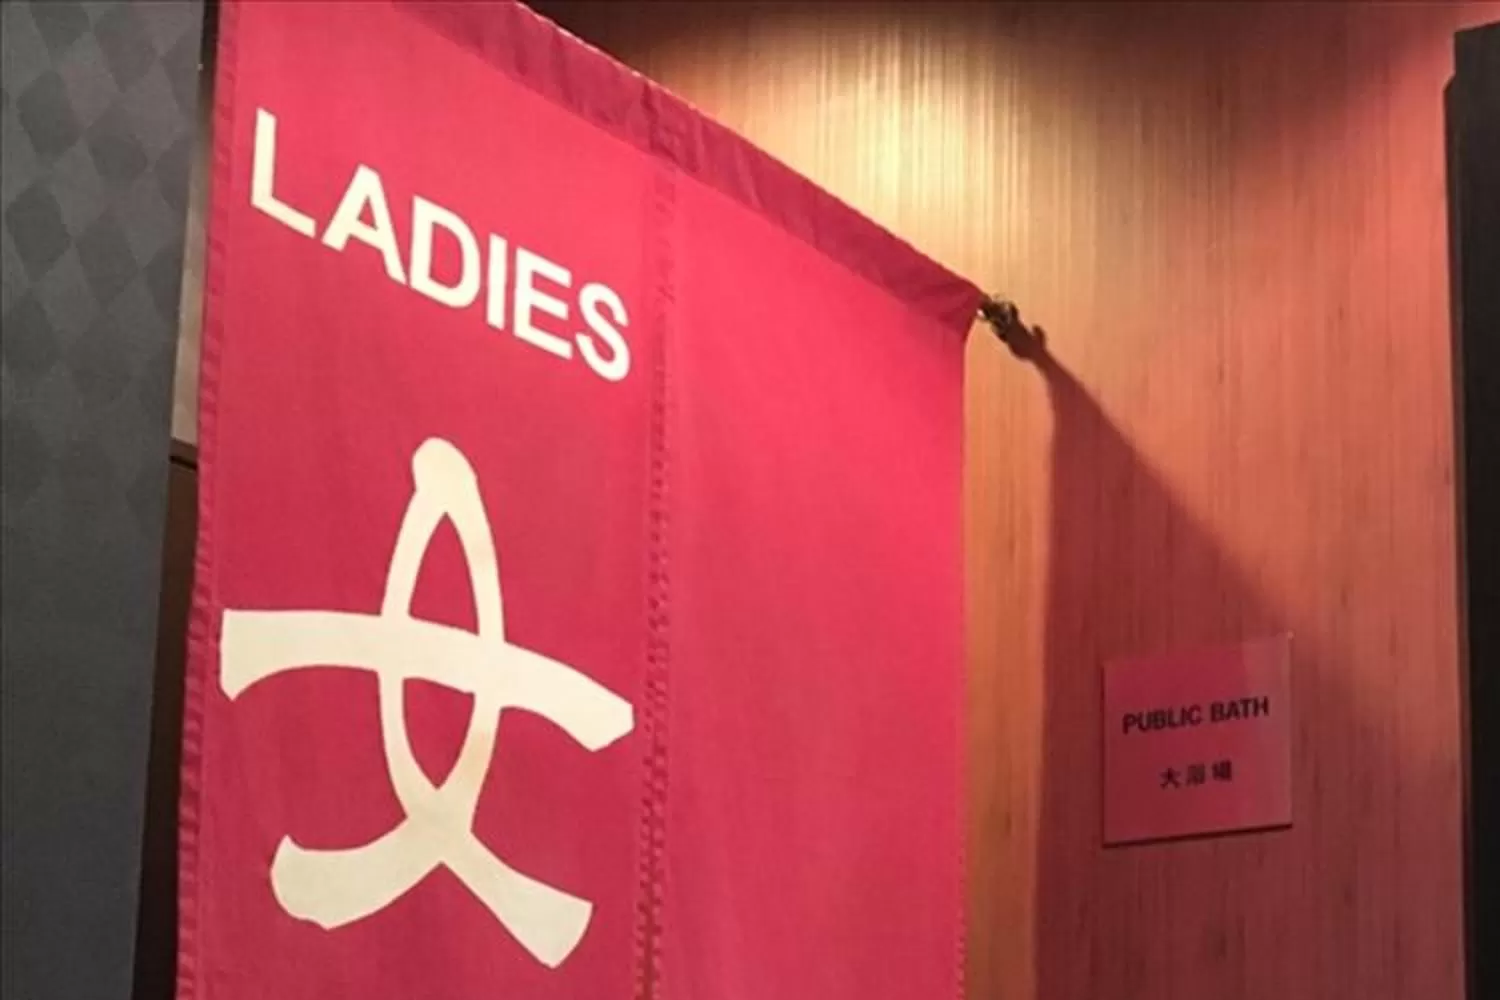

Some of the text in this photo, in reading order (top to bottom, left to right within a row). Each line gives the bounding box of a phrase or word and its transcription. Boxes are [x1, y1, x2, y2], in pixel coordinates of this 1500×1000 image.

[250, 107, 631, 382] LADIES
[220, 437, 635, 969] 女
[1122, 697, 1269, 734] PUBLIC BATH
